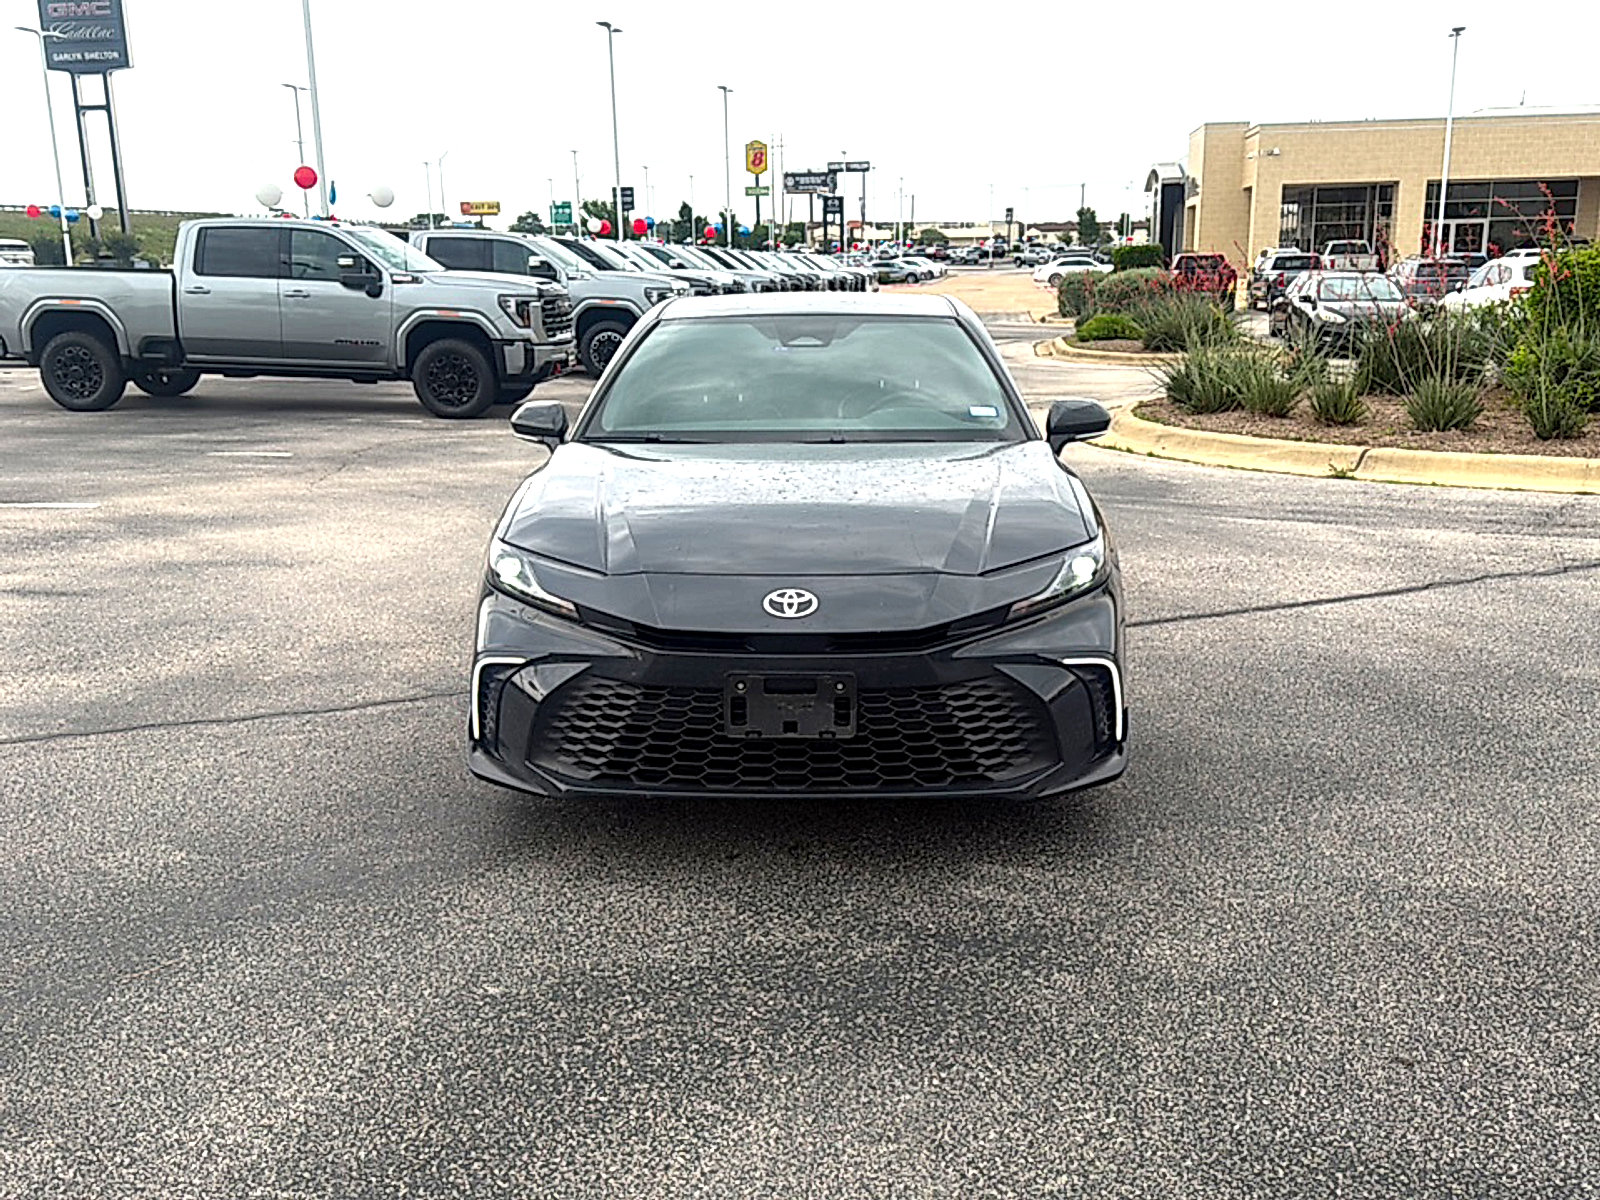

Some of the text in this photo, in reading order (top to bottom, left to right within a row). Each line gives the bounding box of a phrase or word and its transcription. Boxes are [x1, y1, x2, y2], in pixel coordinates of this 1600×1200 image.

[47, 2, 112, 17] GMC
[48, 21, 115, 43] Cadillac
[52, 51, 120, 62] GARLYN SHELTON
[751, 151, 765, 168] 8
